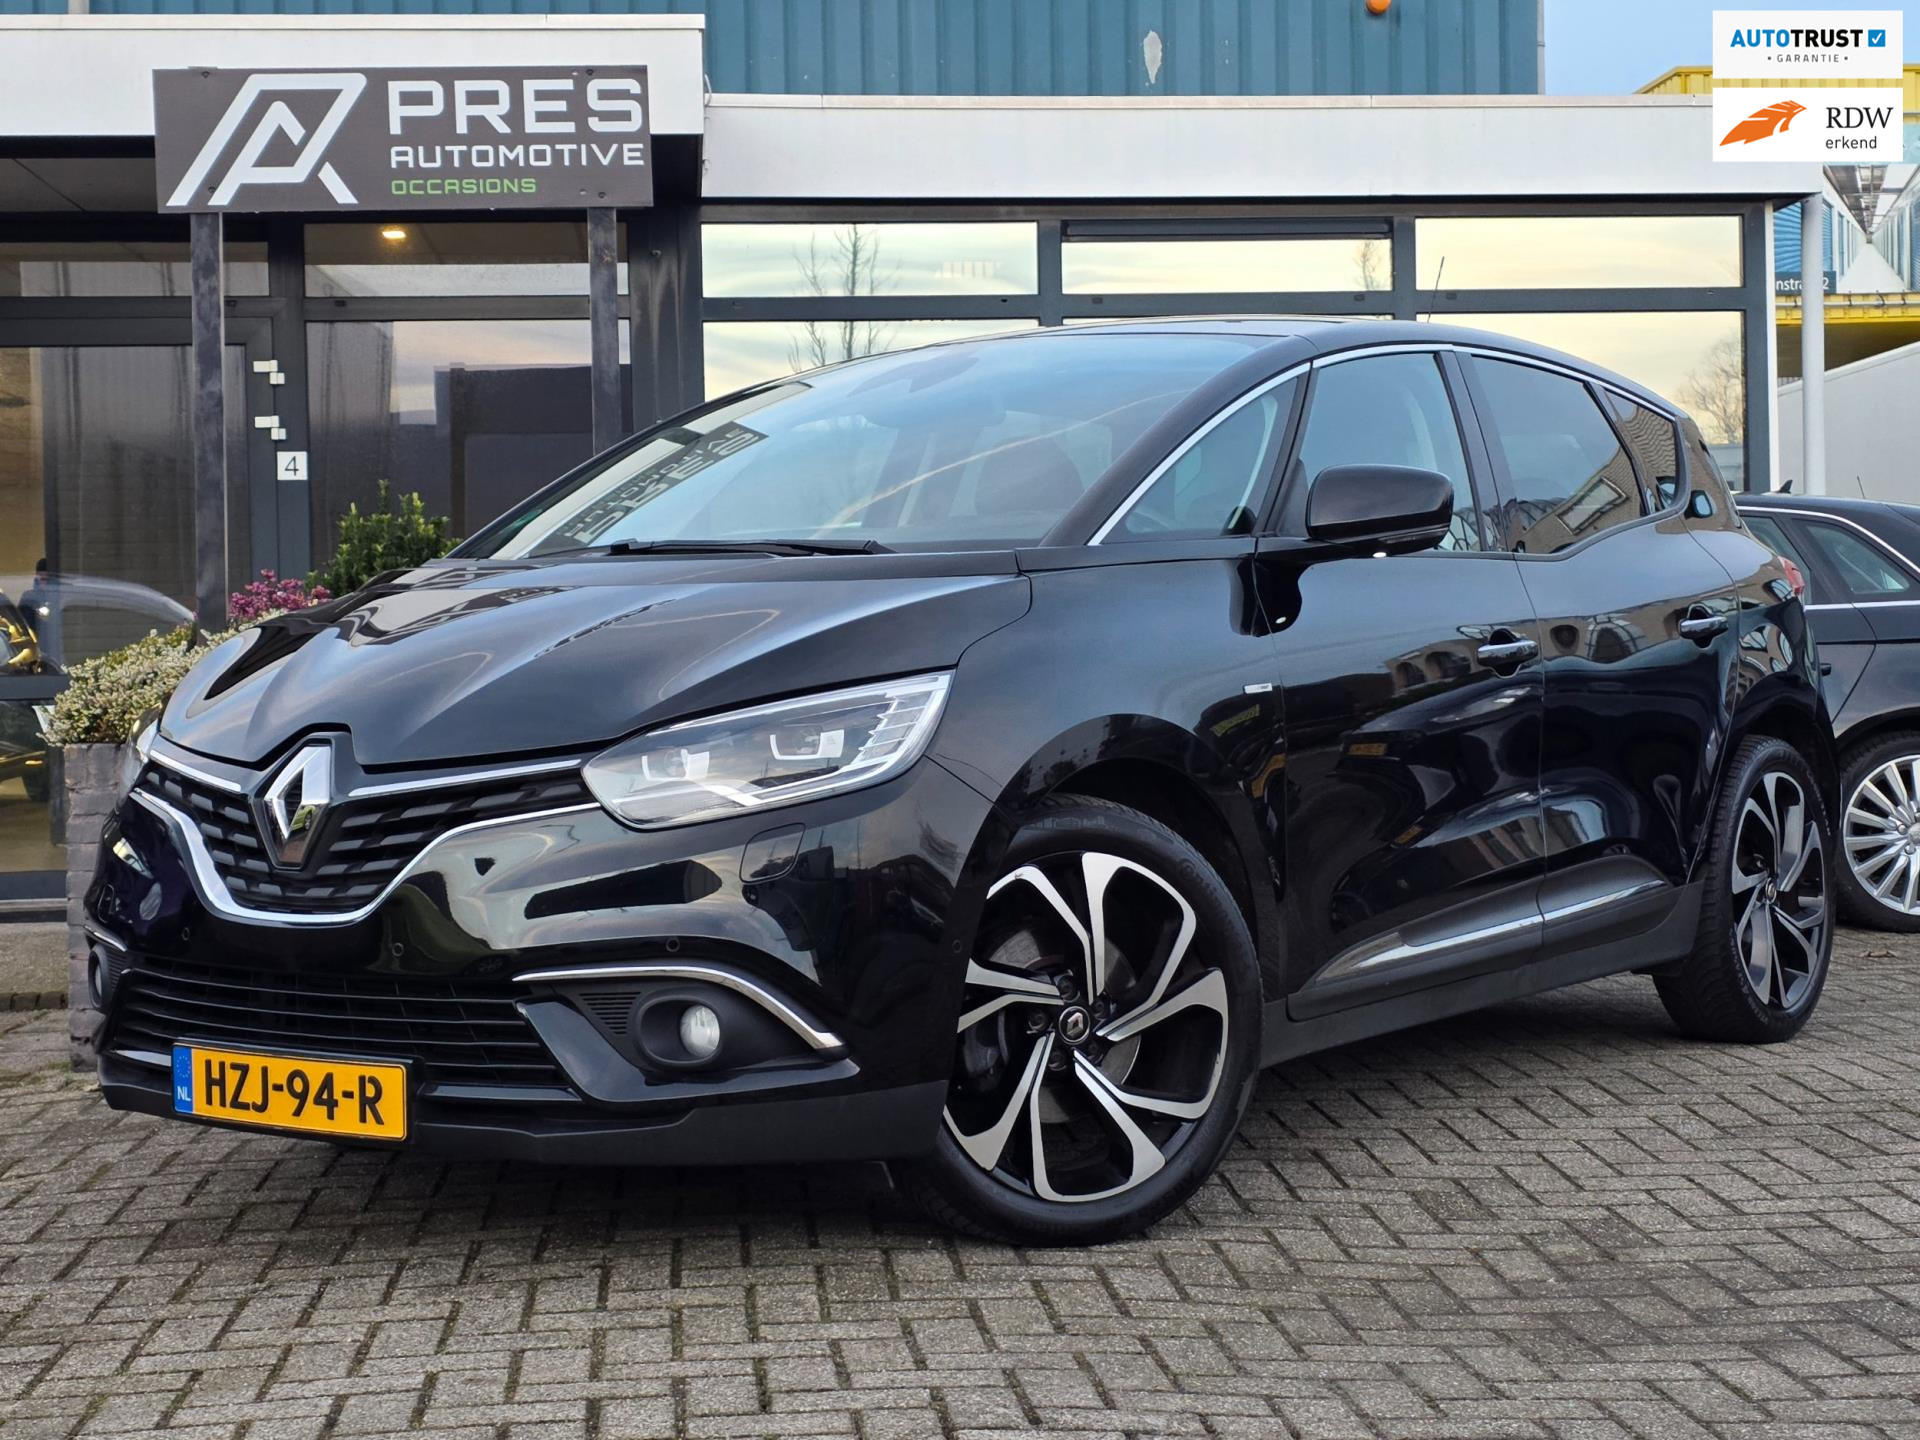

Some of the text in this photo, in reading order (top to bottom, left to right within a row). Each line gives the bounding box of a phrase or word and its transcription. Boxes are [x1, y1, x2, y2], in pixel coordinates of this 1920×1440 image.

[387, 78, 643, 135] PRES
[390, 143, 644, 169] AUTOMOTIVE
[391, 178, 537, 196] OCCASIONS
[1776, 279, 1802, 290] nstr
[284, 455, 299, 476] 4
[177, 1086, 191, 1102] NL
[204, 1059, 385, 1126] HZJ-94-R
